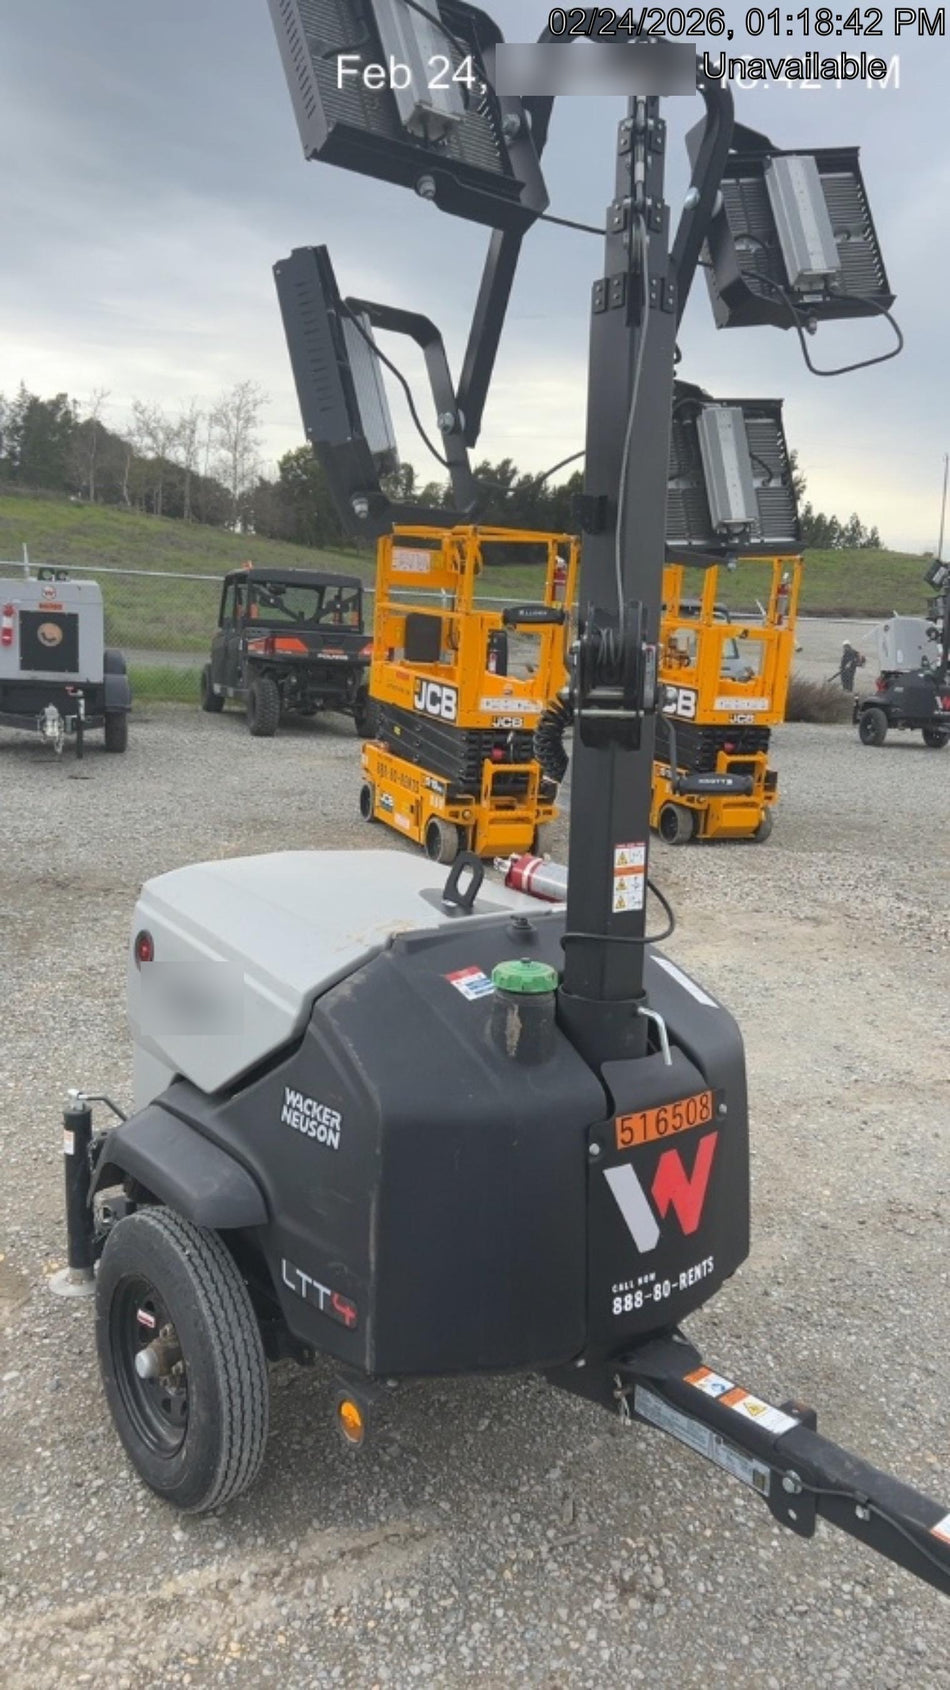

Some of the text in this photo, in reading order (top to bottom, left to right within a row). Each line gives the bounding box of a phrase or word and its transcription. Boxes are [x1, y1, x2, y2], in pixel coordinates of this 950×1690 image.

[413, 679, 458, 721] JCB
[492, 716, 524, 729] JCB
[281, 1104, 341, 1150] NEUSON
[284, 1086, 342, 1132] WACKER
[619, 1094, 711, 1146] 516508
[281, 1258, 357, 1327] LTT4
[611, 1271, 656, 1294] CALL NOW
[612, 1255, 715, 1316] 888-80-RENTS
